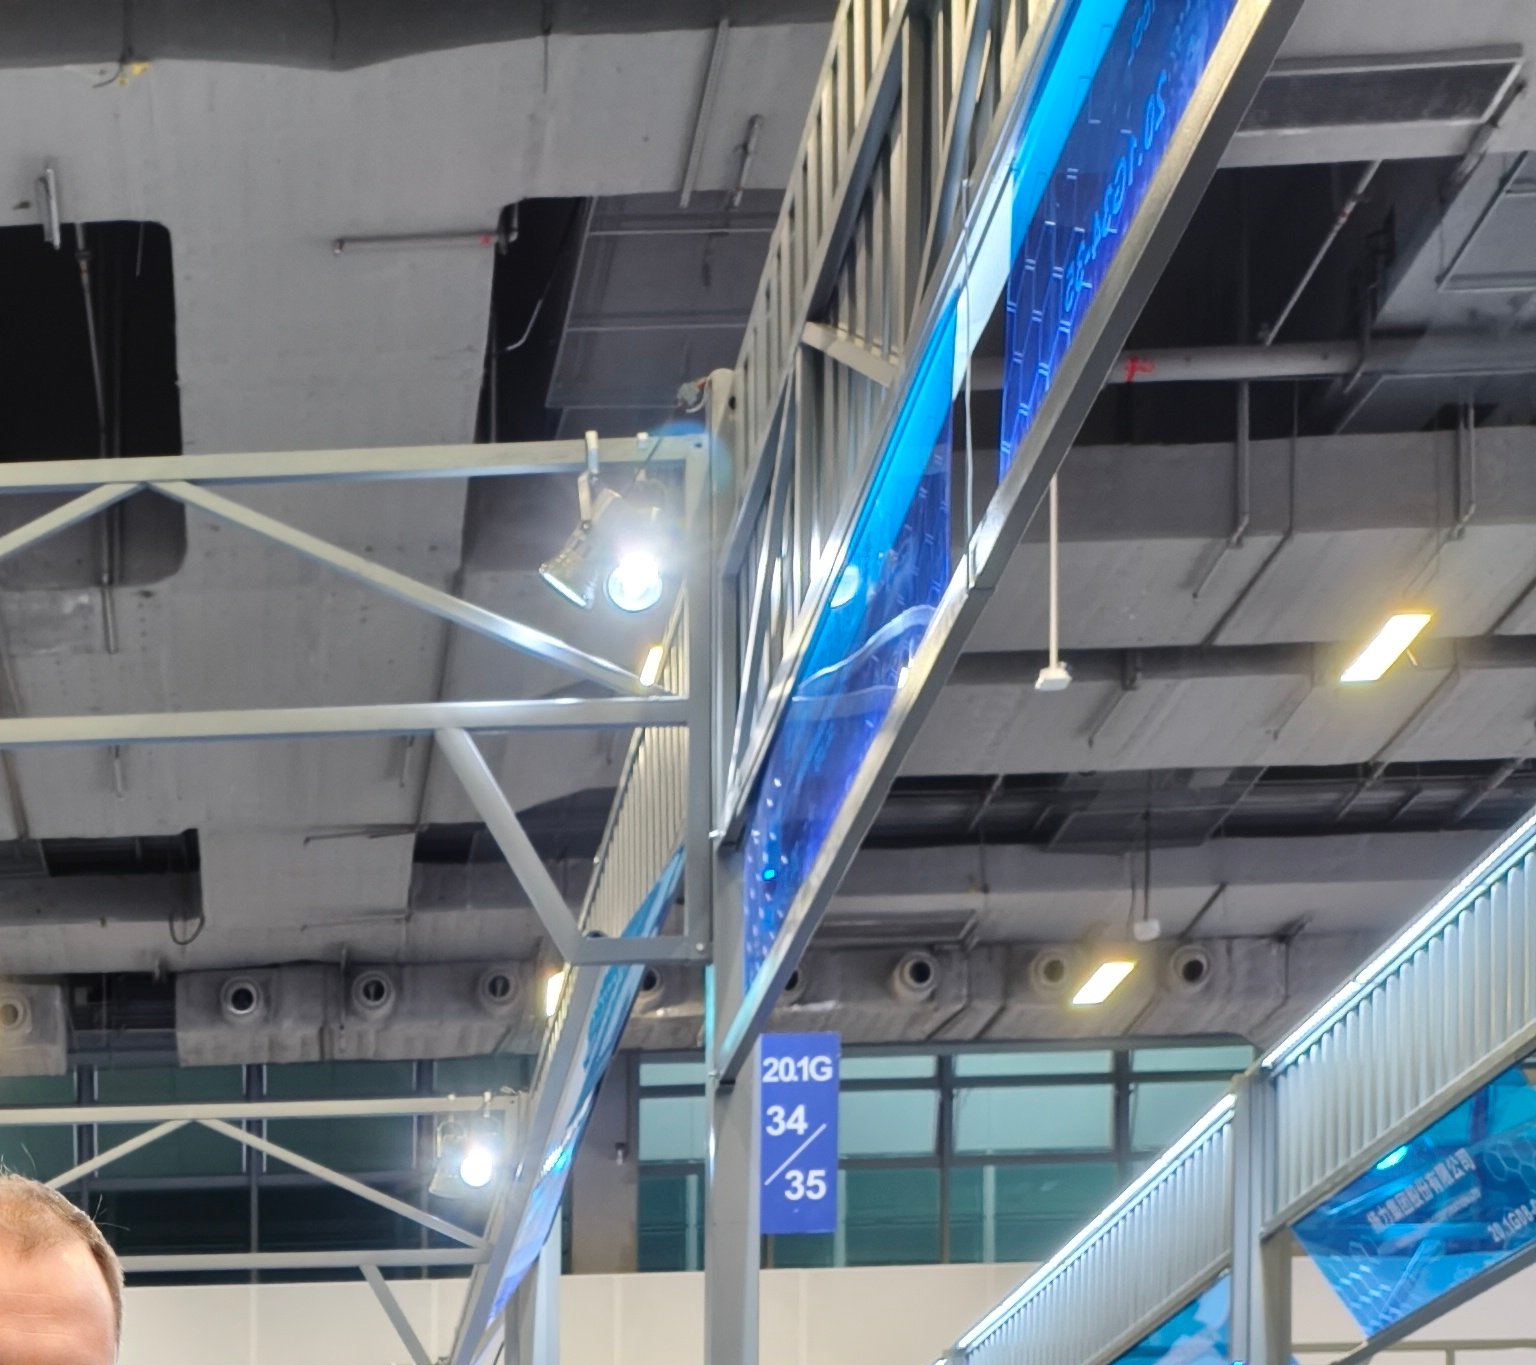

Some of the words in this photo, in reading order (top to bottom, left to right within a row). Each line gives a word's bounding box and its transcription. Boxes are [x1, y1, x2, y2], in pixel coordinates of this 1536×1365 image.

[762, 1055, 833, 1083] 20.1G
[766, 1104, 808, 1136] 34
[784, 1169, 827, 1200] 35
